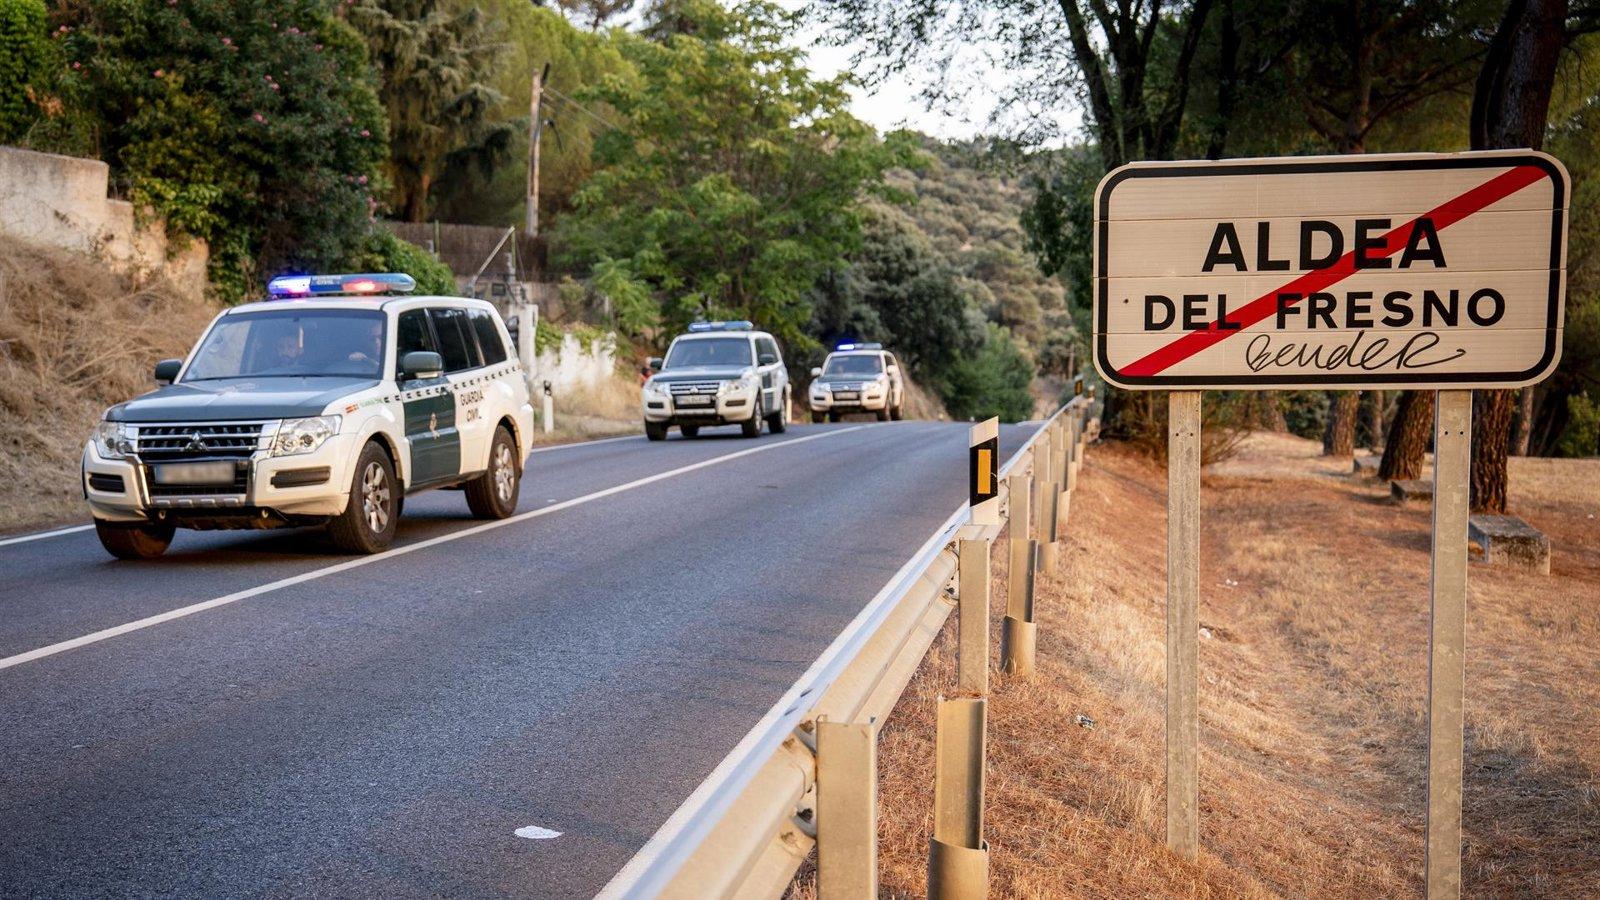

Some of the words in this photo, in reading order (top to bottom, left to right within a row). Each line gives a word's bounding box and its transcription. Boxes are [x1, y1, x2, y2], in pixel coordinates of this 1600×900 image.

[1201, 217, 1447, 272] ALDEA
[1144, 294, 1241, 331] DEL
[1276, 287, 1506, 330] FRESNO
[460, 390, 484, 406] GUARDIA
